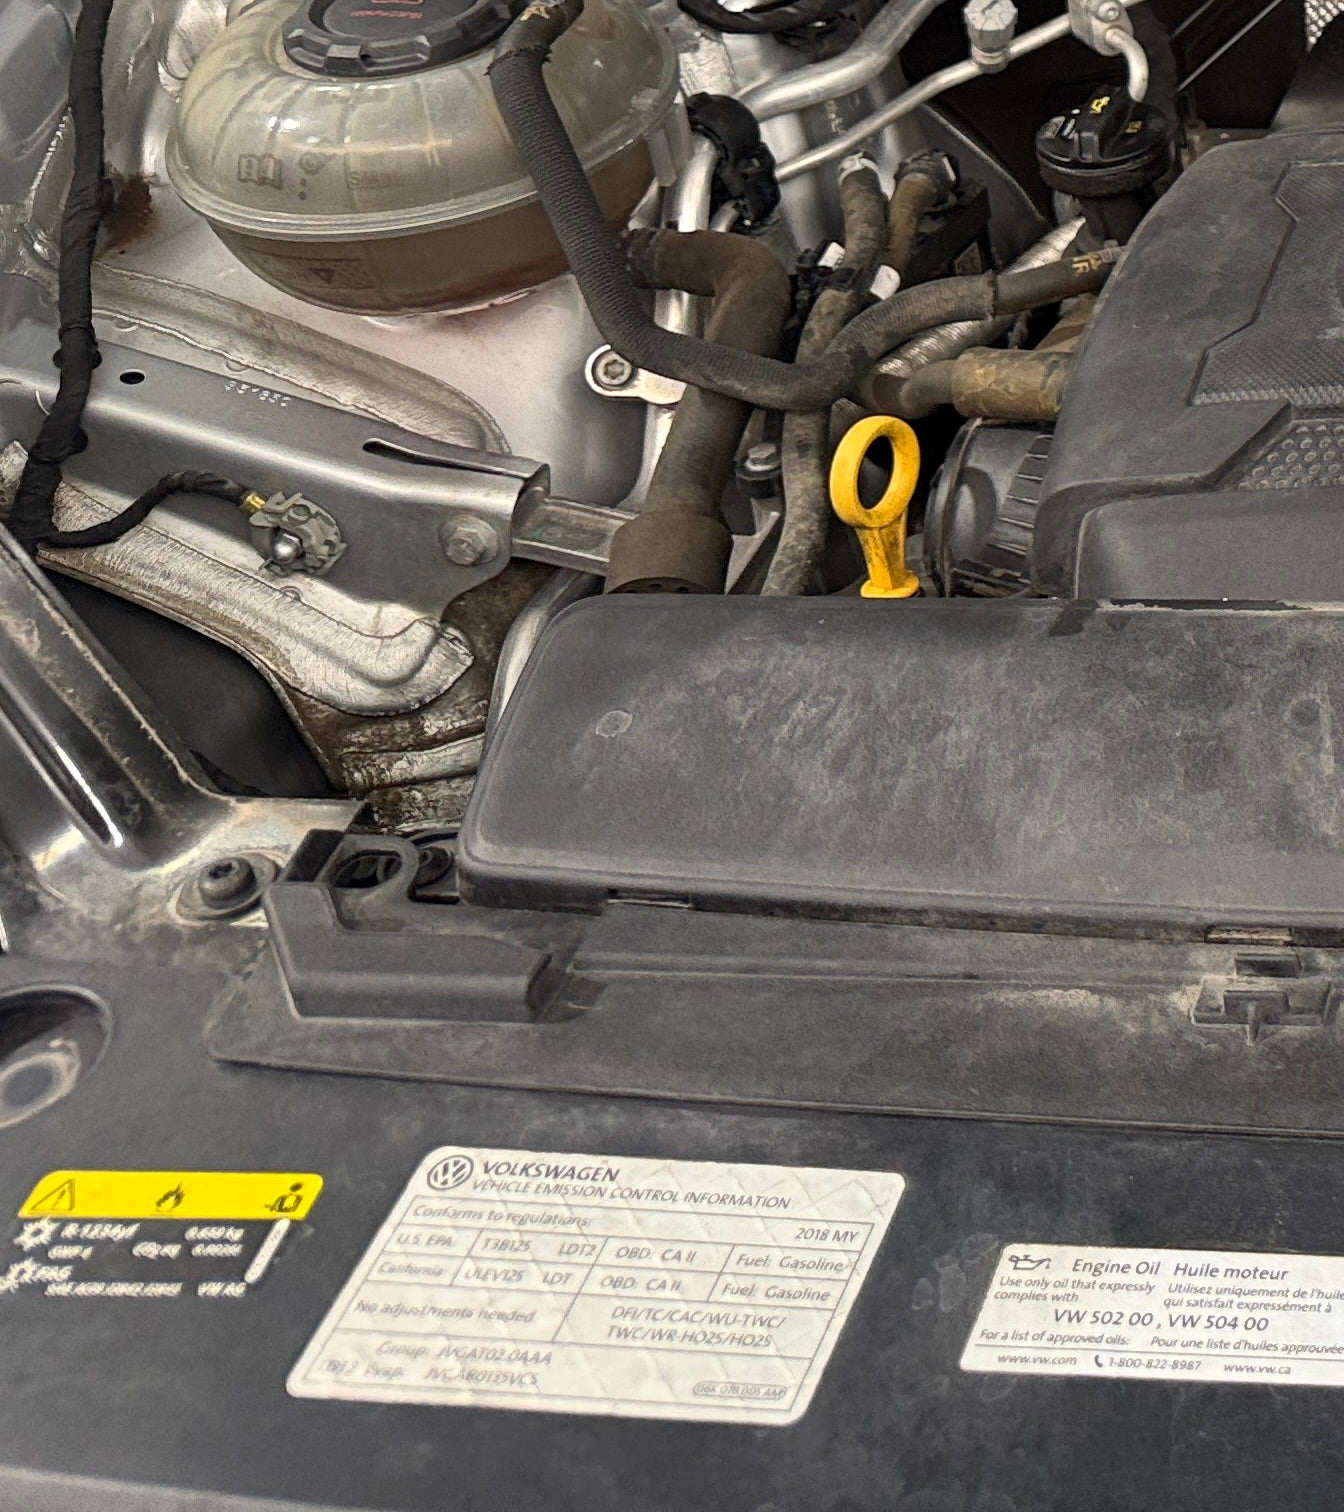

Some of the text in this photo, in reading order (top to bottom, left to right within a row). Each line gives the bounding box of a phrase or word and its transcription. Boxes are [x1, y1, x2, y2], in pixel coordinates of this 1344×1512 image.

[482, 1161, 619, 1182] VOLKSWAGEN
[472, 1179, 791, 1209] VEHICLE EMISSION CONTROL INFORMATION
[413, 1205, 483, 1220] Conforms
[487, 1210, 501, 1221] to
[795, 1227, 861, 1243] 2018 MY
[558, 1242, 597, 1257] LDT2
[661, 1248, 681, 1262] CA
[736, 1254, 845, 1272] Fuel: Gasoline
[1072, 1258, 1161, 1276] Engine Oil
[1173, 1263, 1288, 1280] Huile moteur
[542, 1272, 574, 1285] LDT
[645, 1278, 667, 1291] CA
[1000, 1277, 1155, 1294] Use only oil that expressly
[765, 1285, 831, 1301] Gasoline
[994, 1289, 1079, 1303] complies with
[1168, 1283, 1213, 1294] Utilisez
[1216, 1285, 1289, 1299] uniquement
[1292, 1288, 1307, 1297] de
[355, 1300, 377, 1314] No
[477, 1309, 536, 1323] needed
[1163, 1297, 1183, 1309] qui
[1186, 1298, 1234, 1309] satisfait
[1236, 1300, 1316, 1314] expressément
[1054, 1309, 1269, 1331] VW 502 00 VW 504 00
[980, 1329, 999, 1339] For
[1011, 1330, 1029, 1340] list
[1032, 1331, 1045, 1341] of
[1047, 1332, 1103, 1346] approved
[1150, 1336, 1279, 1351] Pour une liste d'huiles
[998, 1355, 1077, 1365] www.vw.com
[1223, 1364, 1291, 1375] www.vw.ca
